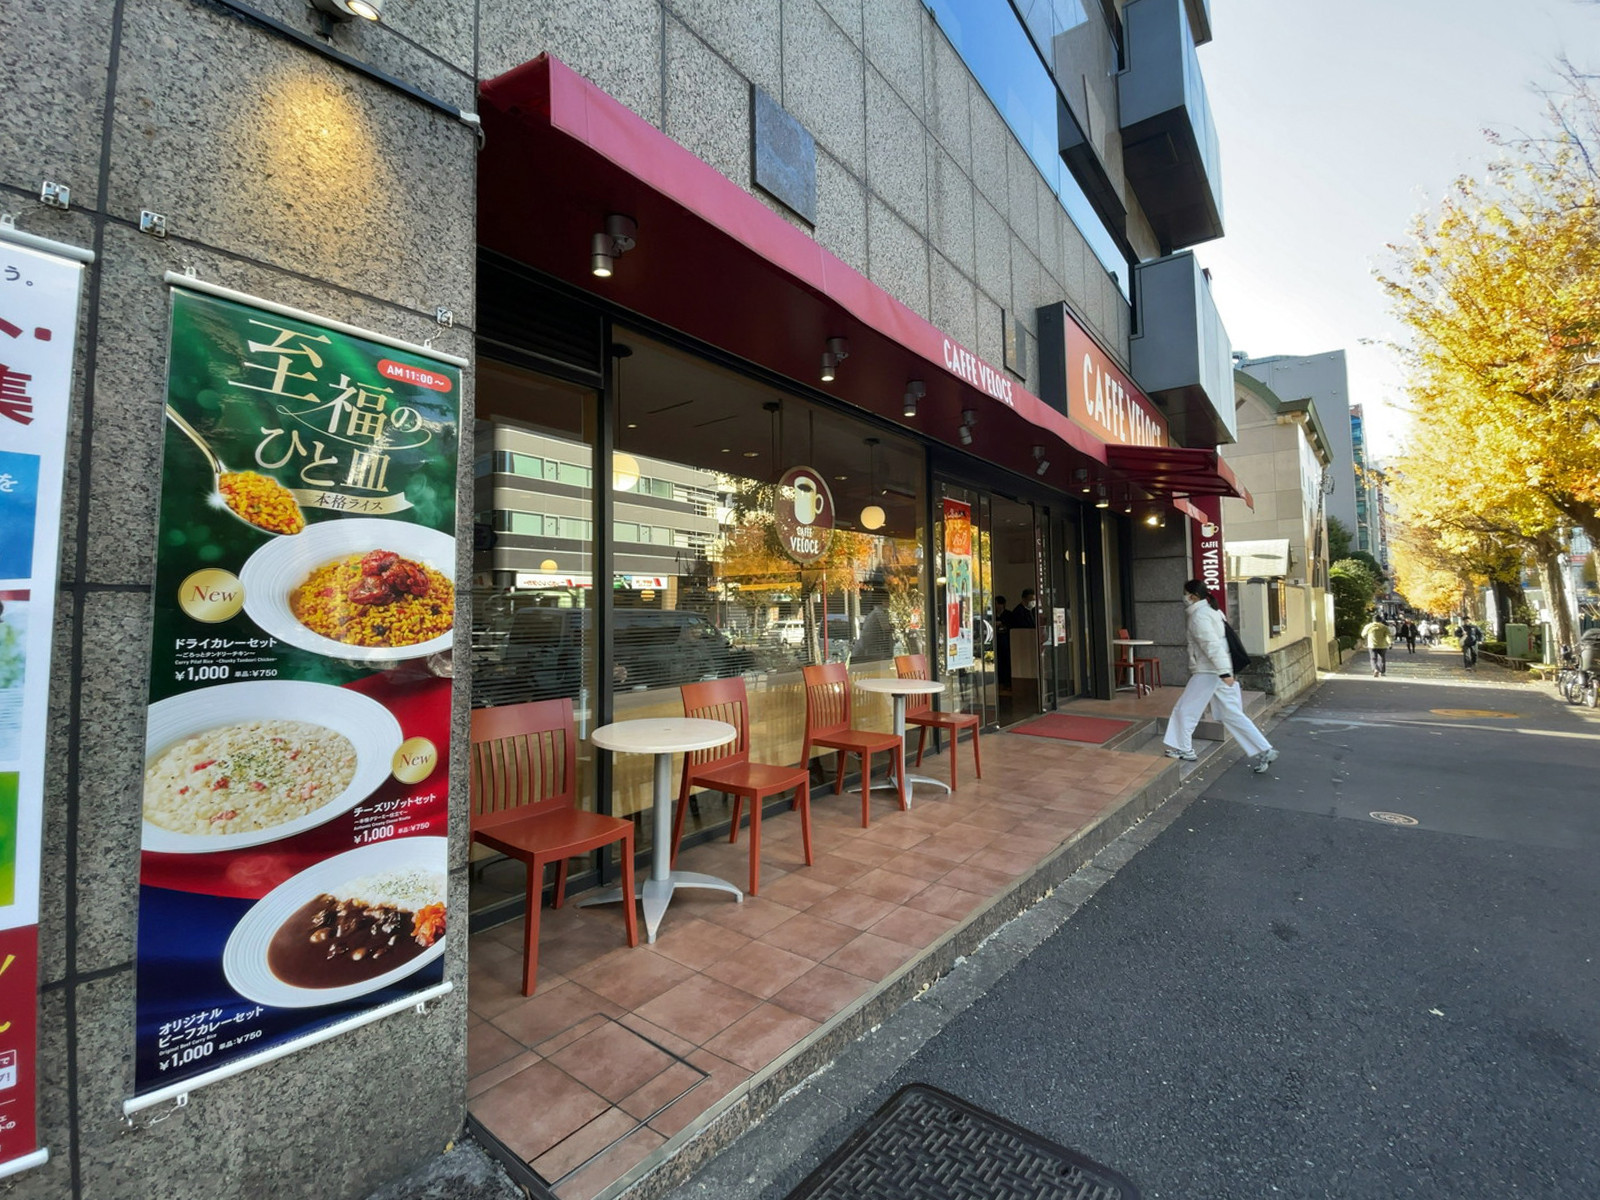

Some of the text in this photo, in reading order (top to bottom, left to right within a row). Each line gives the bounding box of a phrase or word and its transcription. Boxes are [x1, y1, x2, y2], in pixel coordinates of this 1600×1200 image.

[228, 318, 424, 440] 至福の
[387, 364, 404, 377] AM
[978, 361, 1015, 407] VELOCE
[254, 425, 390, 493] ひと皿
[314, 492, 383, 512] 本格ライス
[790, 535, 819, 554] VELOCE
[191, 585, 238, 603] New
[175, 638, 277, 650] ドライカレーセット
[174, 665, 230, 681] ¥1,000
[400, 753, 431, 768] New
[353, 793, 436, 817] チーズリゾットセット
[353, 824, 394, 844] ¥1,000
[158, 1008, 223, 1036] オリジナル
[158, 1005, 264, 1049] ビーフカレーセット
[159, 1041, 214, 1071] ¥1,000
